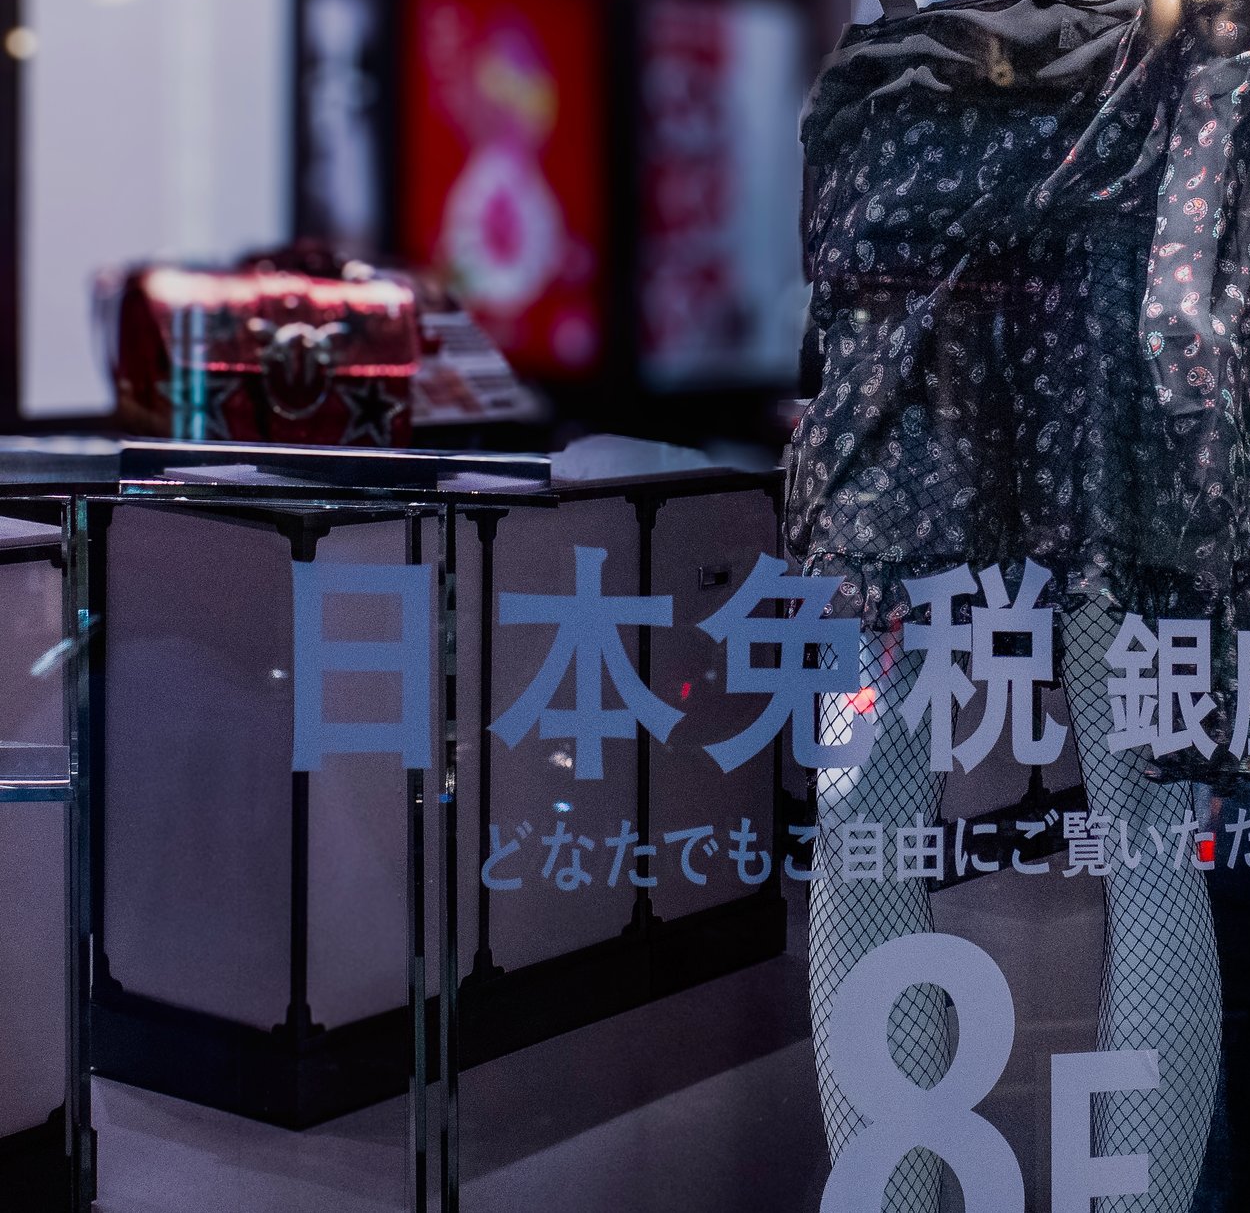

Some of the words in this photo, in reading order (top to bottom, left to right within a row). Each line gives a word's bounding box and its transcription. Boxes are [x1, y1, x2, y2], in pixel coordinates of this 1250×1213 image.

[291, 545, 1068, 780] 日本免税
[819, 932, 1160, 1213] 8F
